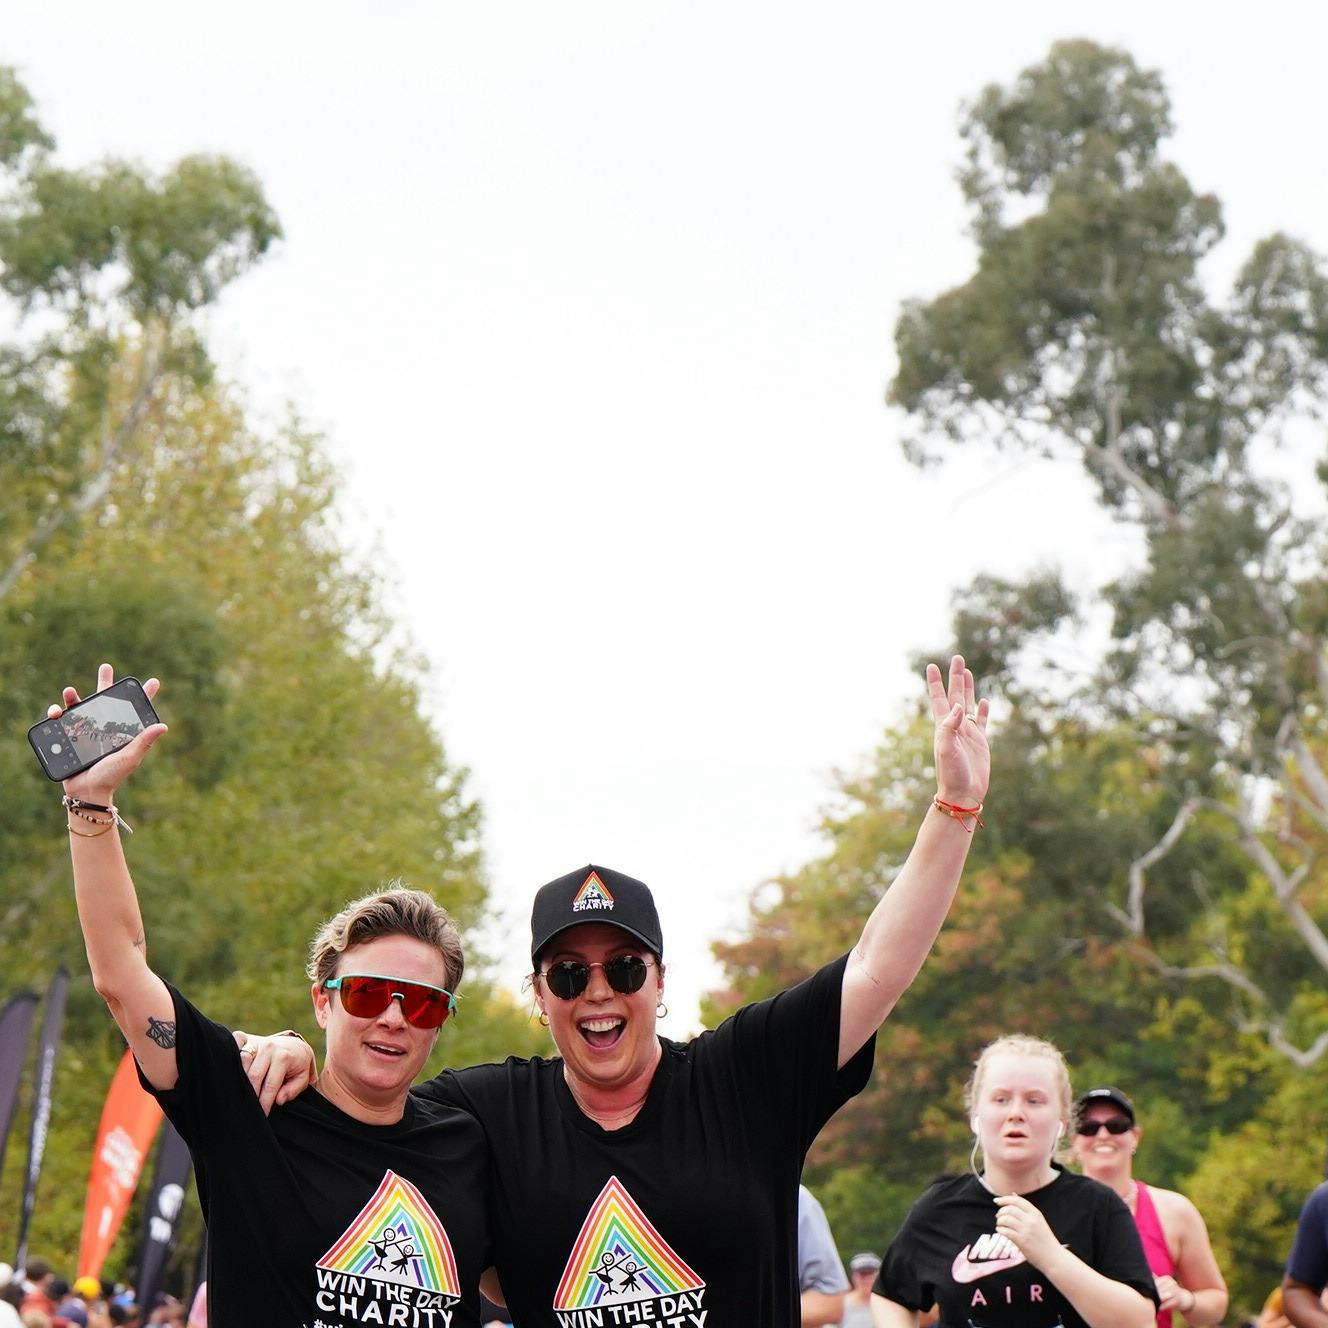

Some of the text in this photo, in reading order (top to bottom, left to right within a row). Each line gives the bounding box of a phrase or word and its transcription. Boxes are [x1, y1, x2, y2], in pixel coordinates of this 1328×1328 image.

[573, 902, 614, 912] CHARITY
[316, 1269, 462, 1309] WIN THE DAY
[971, 1284, 1044, 1307] AIR
[608, 1300, 655, 1325] THE
[660, 1289, 706, 1318] DAY
